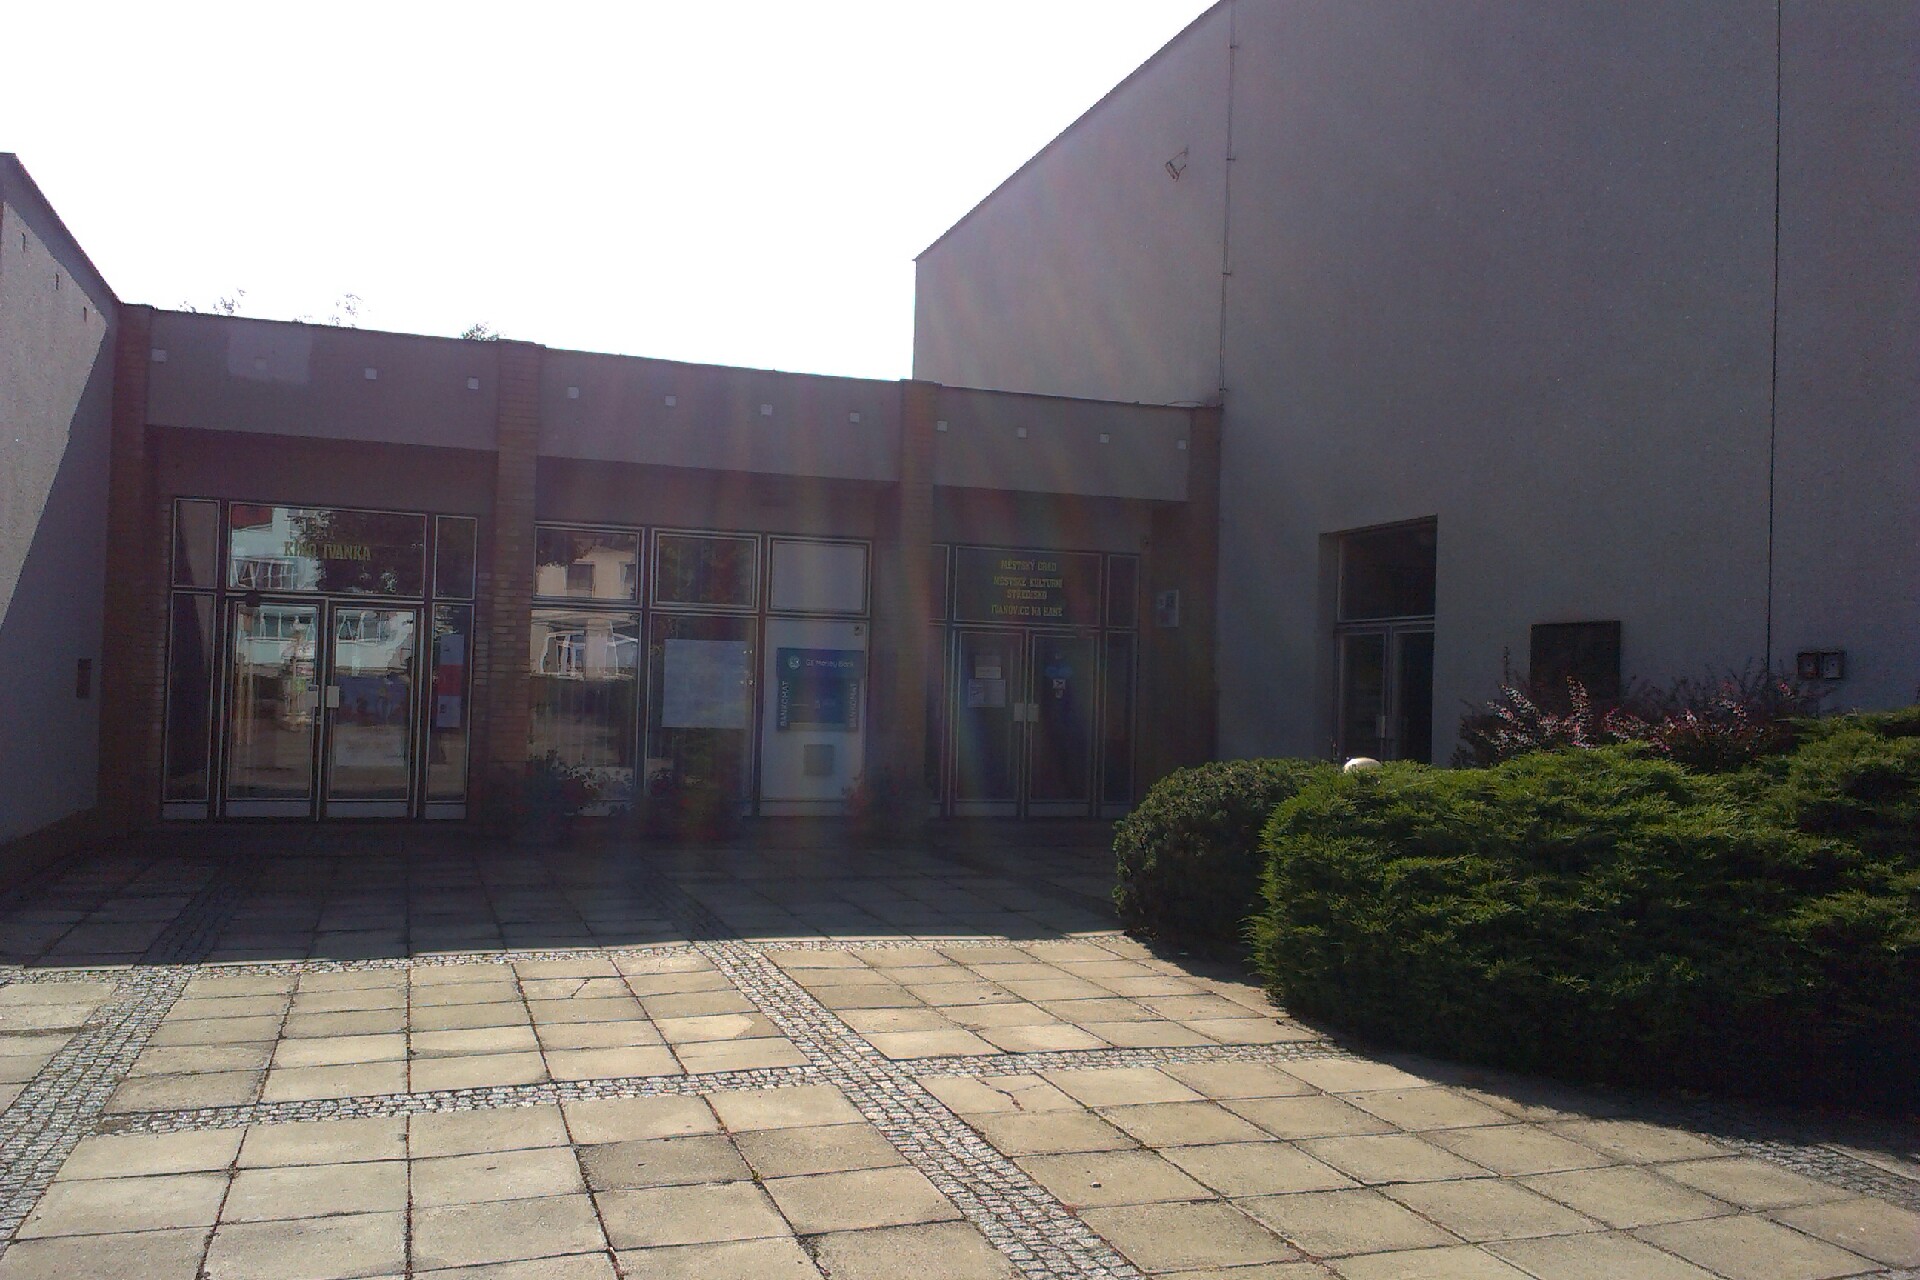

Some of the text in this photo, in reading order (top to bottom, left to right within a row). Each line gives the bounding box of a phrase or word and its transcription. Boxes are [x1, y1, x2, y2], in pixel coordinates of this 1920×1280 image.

[283, 541, 371, 561] KINO IVANKA
[780, 680, 789, 727] BANKOMAT
[848, 682, 857, 728] BANKOMAT
